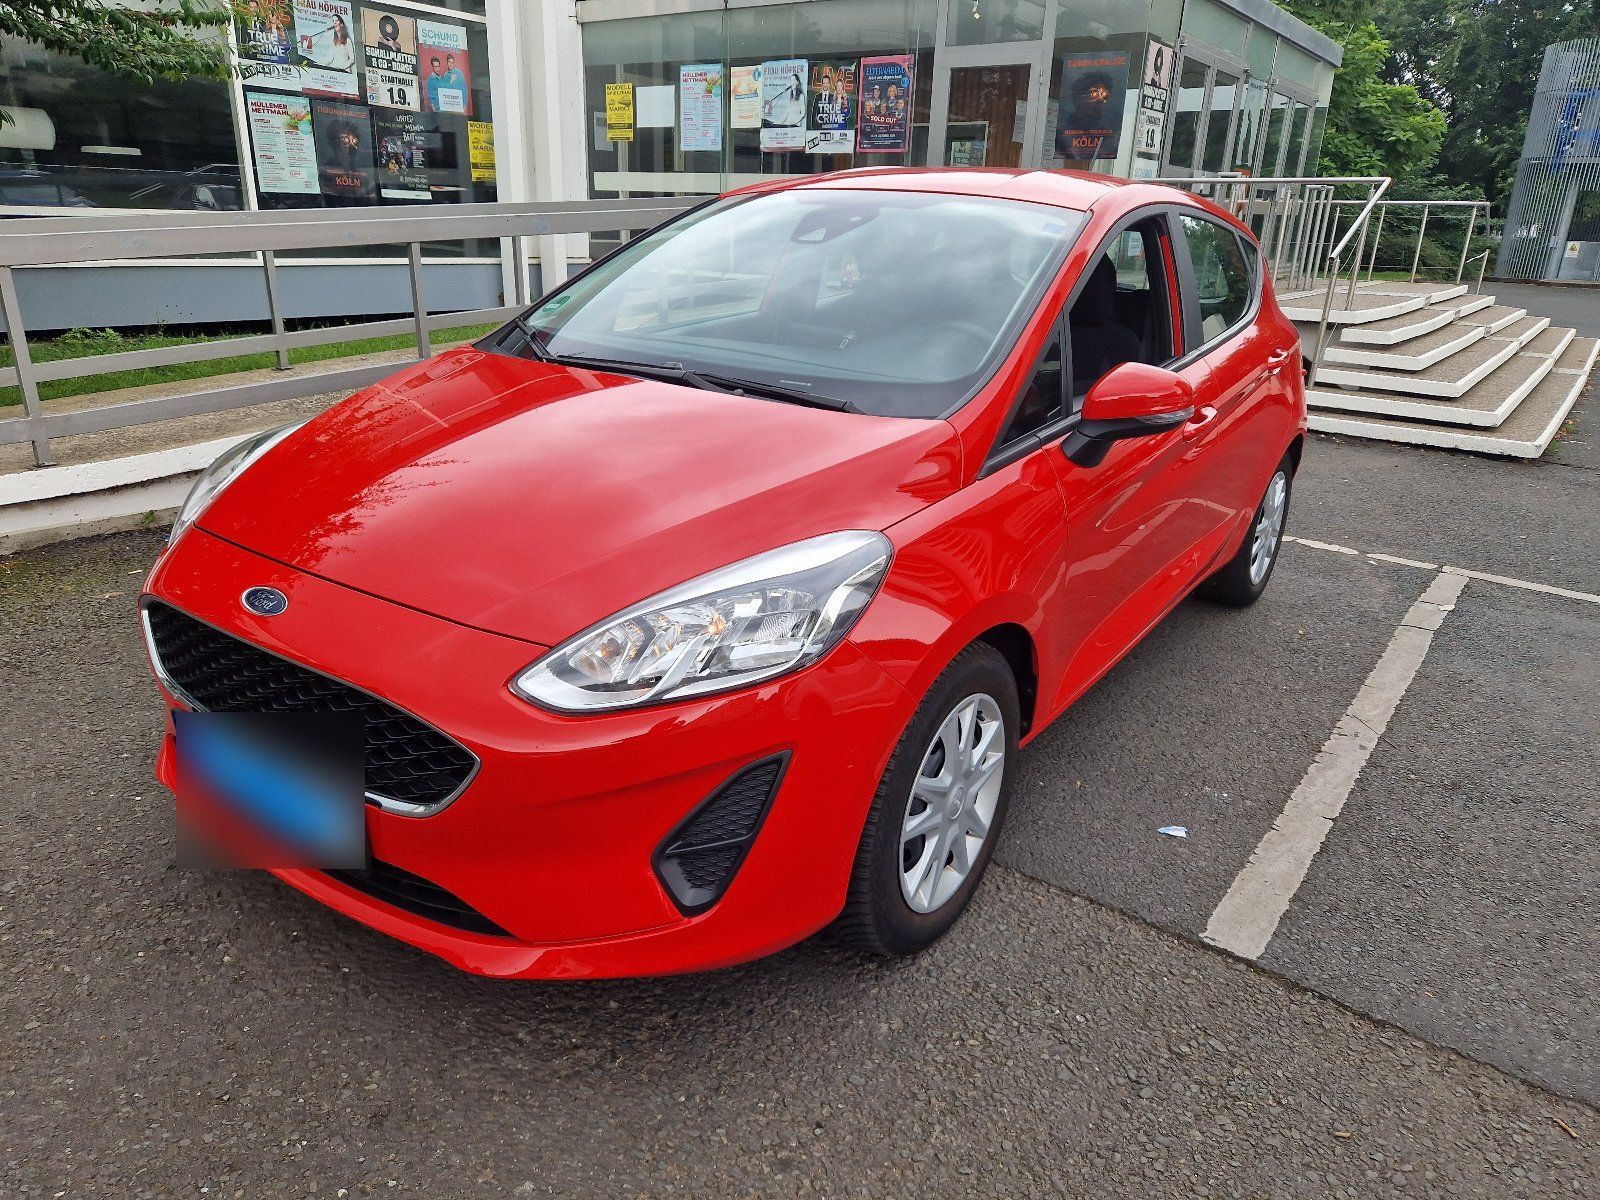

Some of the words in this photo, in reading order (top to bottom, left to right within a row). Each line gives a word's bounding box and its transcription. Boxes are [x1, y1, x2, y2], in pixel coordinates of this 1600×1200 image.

[248, 29, 279, 45] TRUE
[421, 28, 459, 43] SCHUND
[365, 47, 417, 66] SCHALLPLATTEN
[372, 58, 378, 66] &
[379, 59, 388, 68] CD
[764, 67, 779, 75] FRAU
[380, 74, 414, 87] STADTHALLE
[387, 87, 411, 106] 1.9.
[250, 101, 288, 110] MÜLLEMER
[818, 103, 842, 113] TRUE
[816, 113, 846, 123] CRIME
[469, 122, 494, 130] MODEL
[1072, 135, 1102, 147] KÖLN
[335, 175, 360, 187] KÖLN
